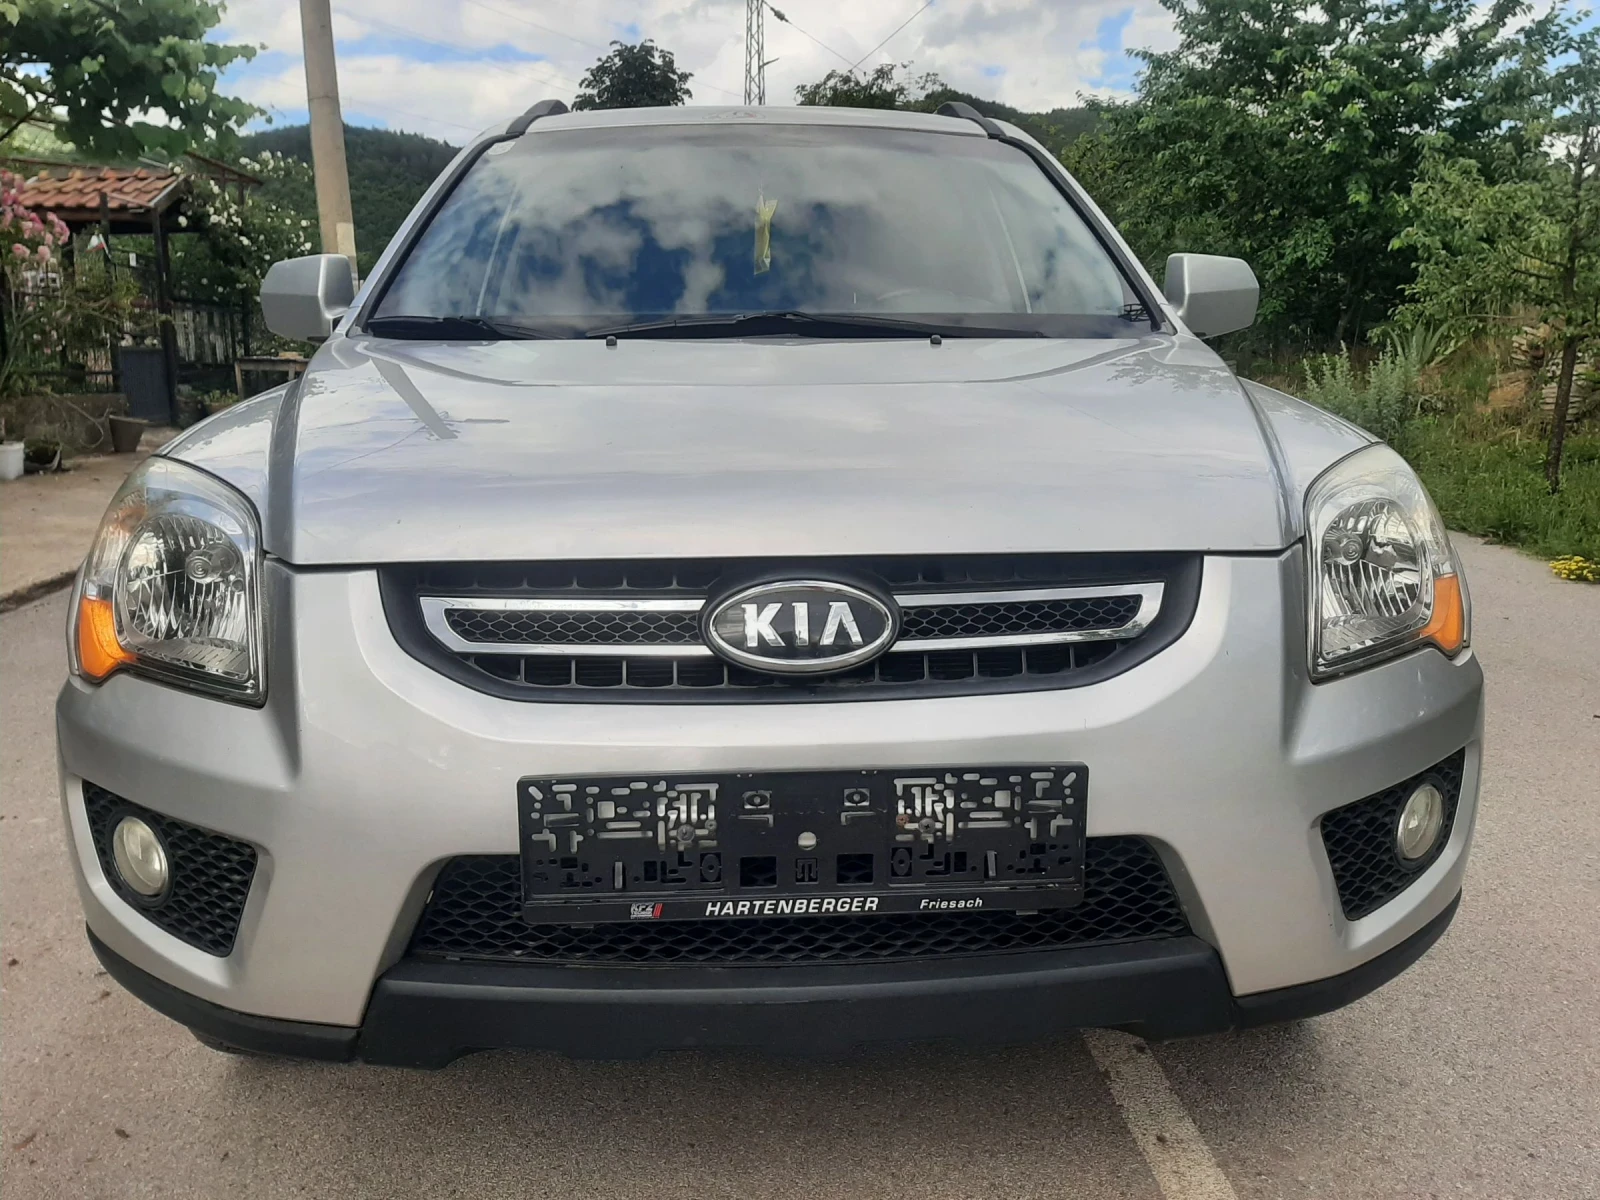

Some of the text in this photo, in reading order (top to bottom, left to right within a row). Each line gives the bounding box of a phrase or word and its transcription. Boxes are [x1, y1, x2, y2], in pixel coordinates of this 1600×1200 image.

[741, 602, 863, 646] KIA
[705, 897, 879, 916] HARTENBERGER
[919, 897, 983, 910] Friesach
